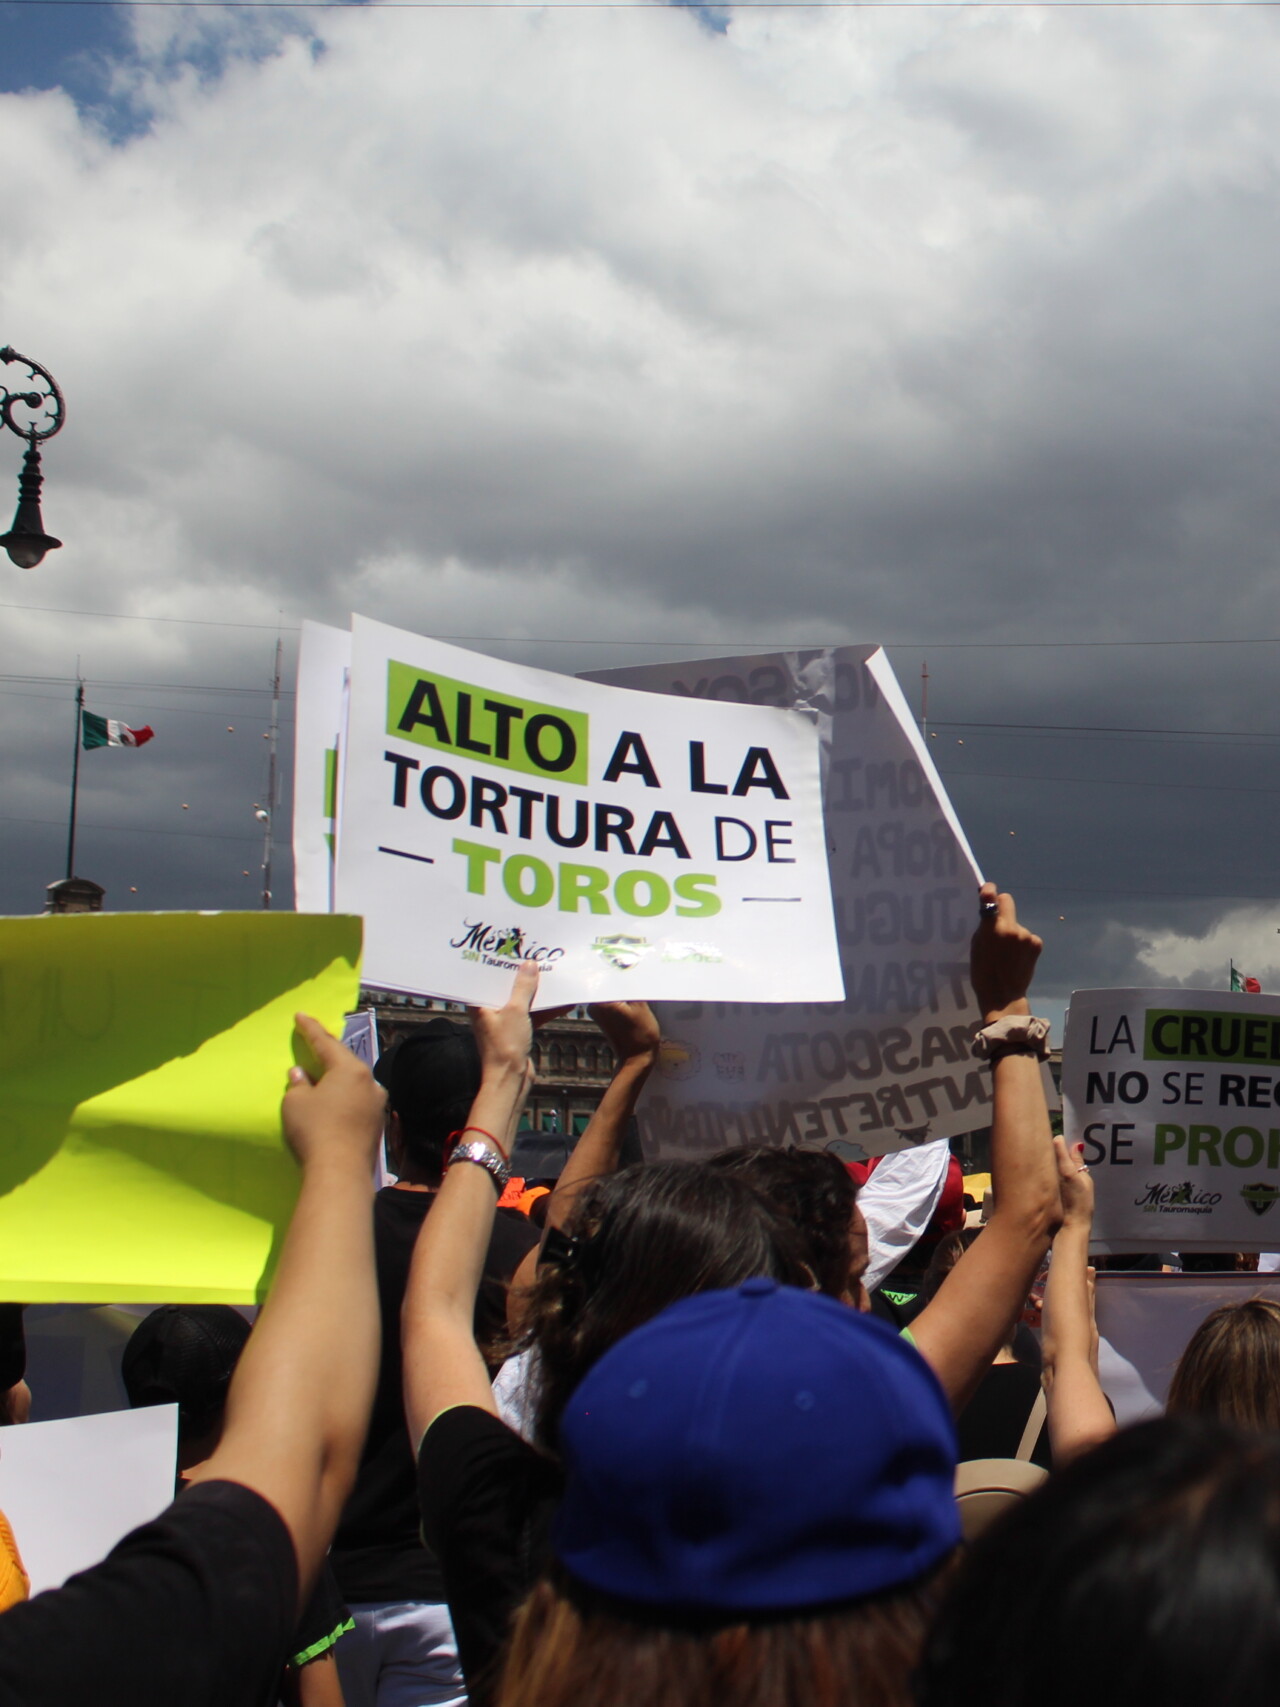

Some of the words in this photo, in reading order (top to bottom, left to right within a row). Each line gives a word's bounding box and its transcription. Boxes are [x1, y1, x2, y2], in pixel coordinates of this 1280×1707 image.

[397, 679, 577, 773] ALTO
[602, 730, 661, 789] A
[690, 740, 790, 799] LA
[384, 751, 692, 859] TORTURA
[715, 816, 796, 863] DE
[452, 838, 722, 919] TOROS
[461, 949, 479, 962] SIN
[1089, 1015, 1136, 1055] LA
[1086, 1071, 1149, 1105] NO
[1162, 1071, 1204, 1105] SE
[1082, 1123, 1136, 1166] SE
